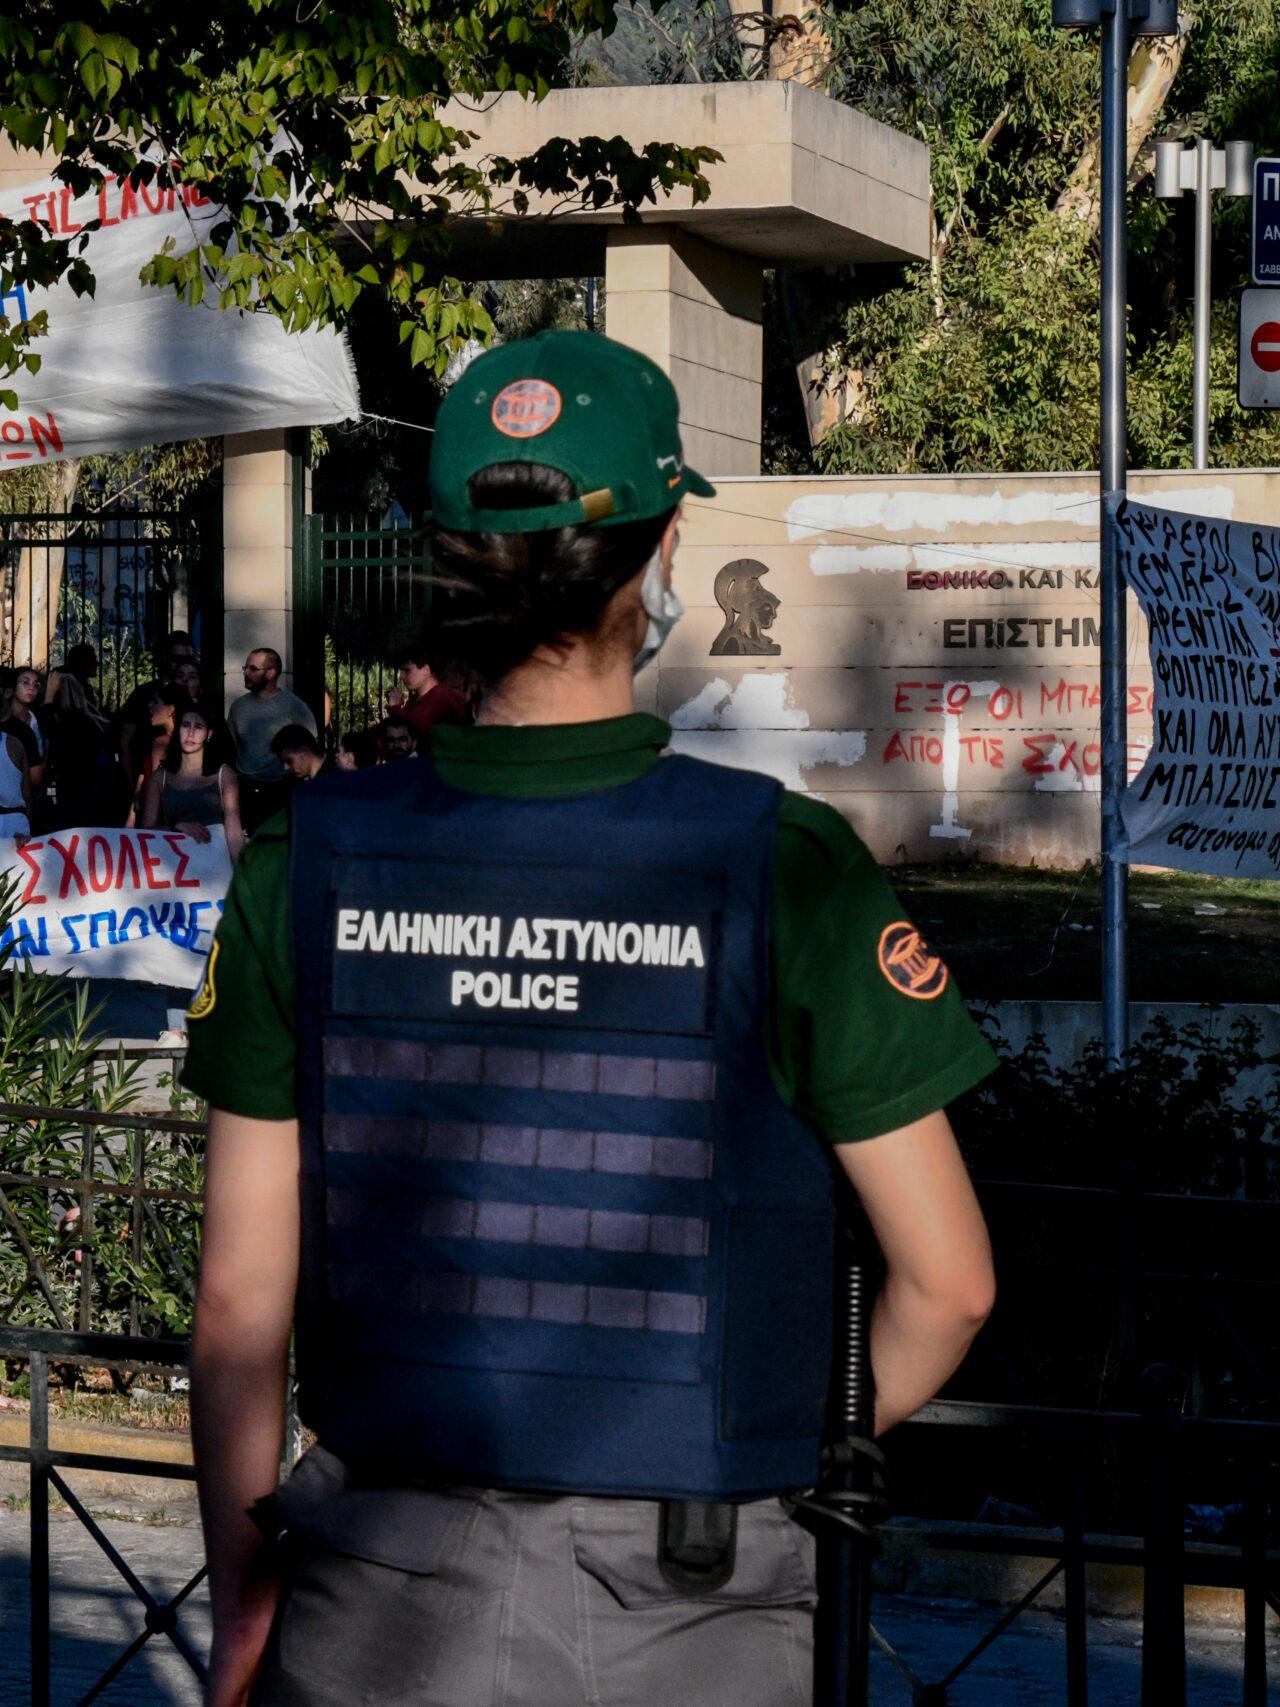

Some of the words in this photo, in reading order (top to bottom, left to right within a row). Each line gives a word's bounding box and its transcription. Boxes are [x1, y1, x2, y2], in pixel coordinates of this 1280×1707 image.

[1019, 568, 1063, 589] ΚΑΙ
[943, 617, 1101, 649] ΕΠΙΣΤΗΜ
[883, 730, 943, 765] ΑΠΟ
[958, 735, 1004, 768] ΤΙΣ
[1157, 708, 1196, 755] ΚΑΙ
[17, 833, 200, 905] ΣΧΟΛΕΣ
[336, 909, 500, 957] ΕΛΛΗΝΙΚΗ
[506, 917, 705, 967] ΑΣΤΥΝΟΜΙΑ
[451, 970, 579, 1011] POLICE
